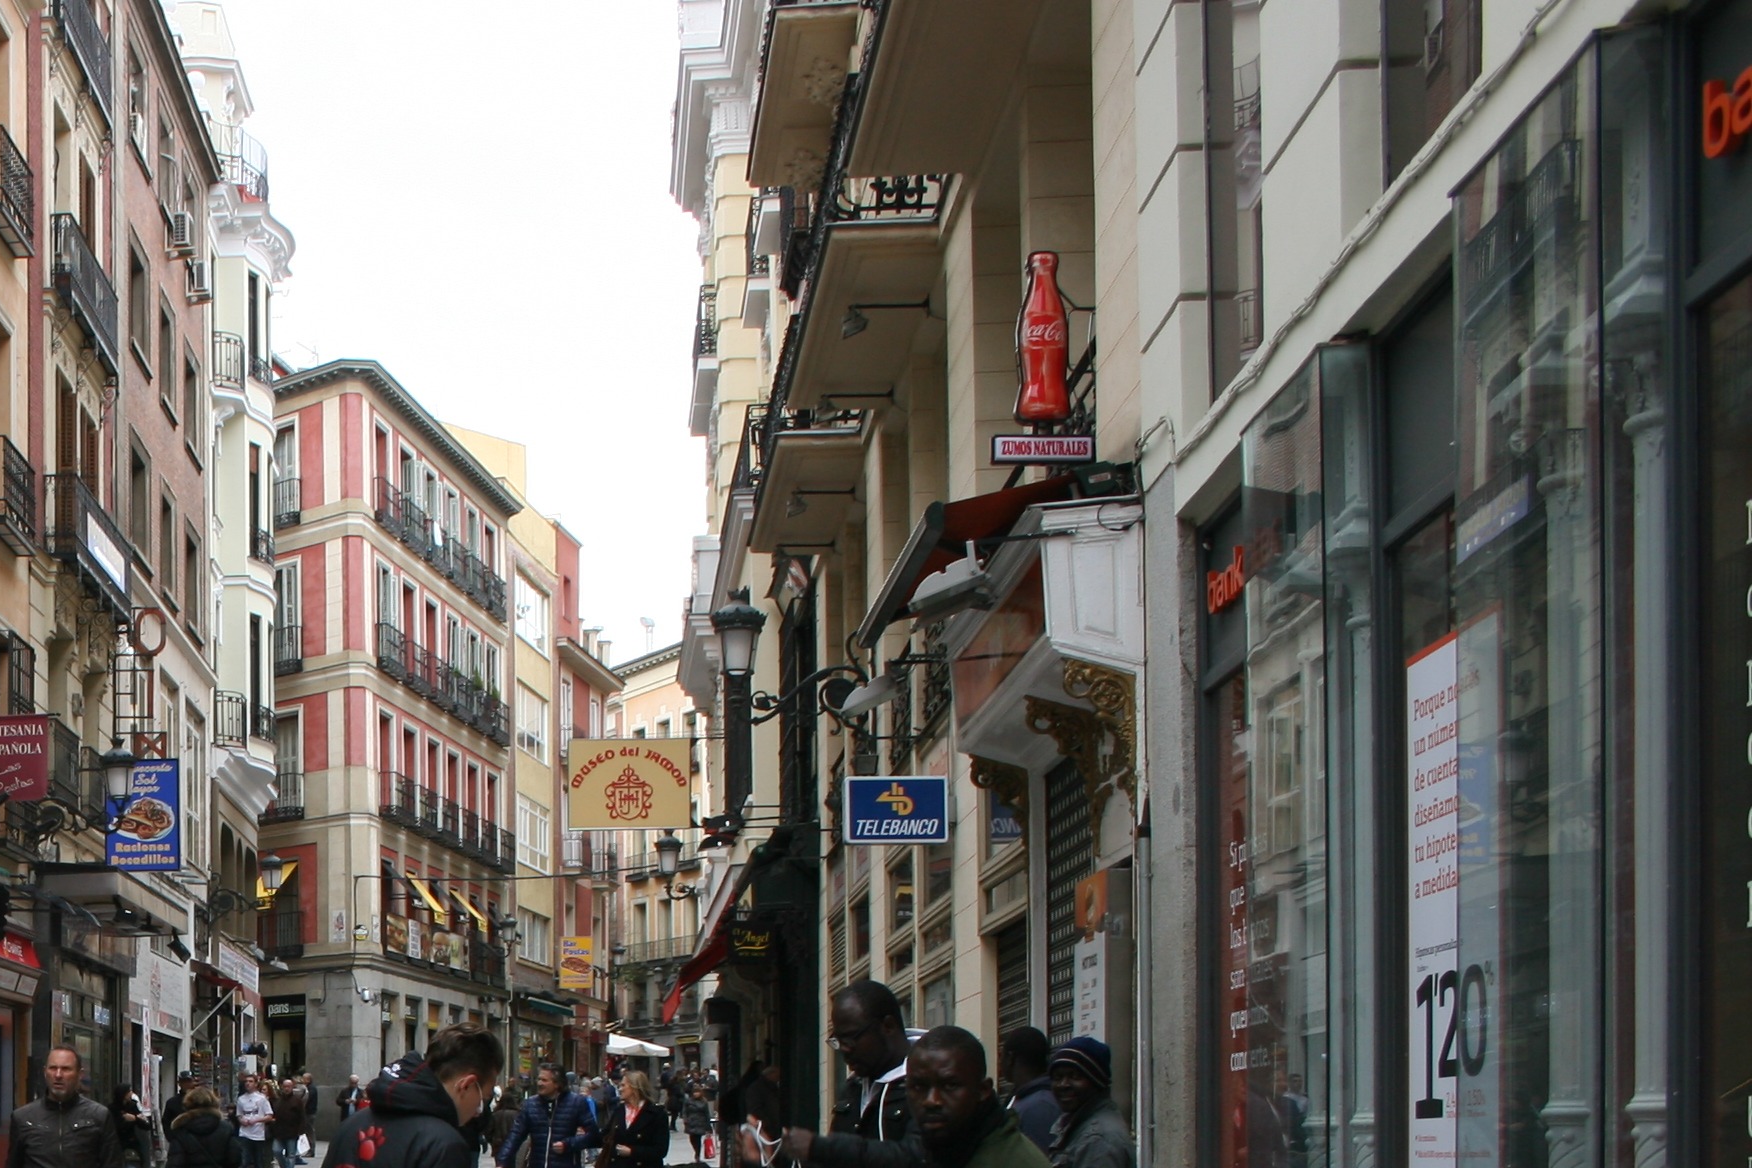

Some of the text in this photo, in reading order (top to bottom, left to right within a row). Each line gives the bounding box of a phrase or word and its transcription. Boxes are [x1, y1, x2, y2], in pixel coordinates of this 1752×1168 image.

[1001, 440, 1088, 457] ZUMOS NATURALES
[1414, 690, 1445, 721] Porque
[620, 746, 639, 757] del
[1414, 738, 1426, 756] un
[1414, 766, 1426, 792] de
[856, 818, 939, 836] TELEBANCO
[115, 842, 171, 853] Raciones
[1415, 843, 1425, 863] tu
[111, 854, 176, 866] Bocadillos
[268, 1003, 290, 1018] pans
